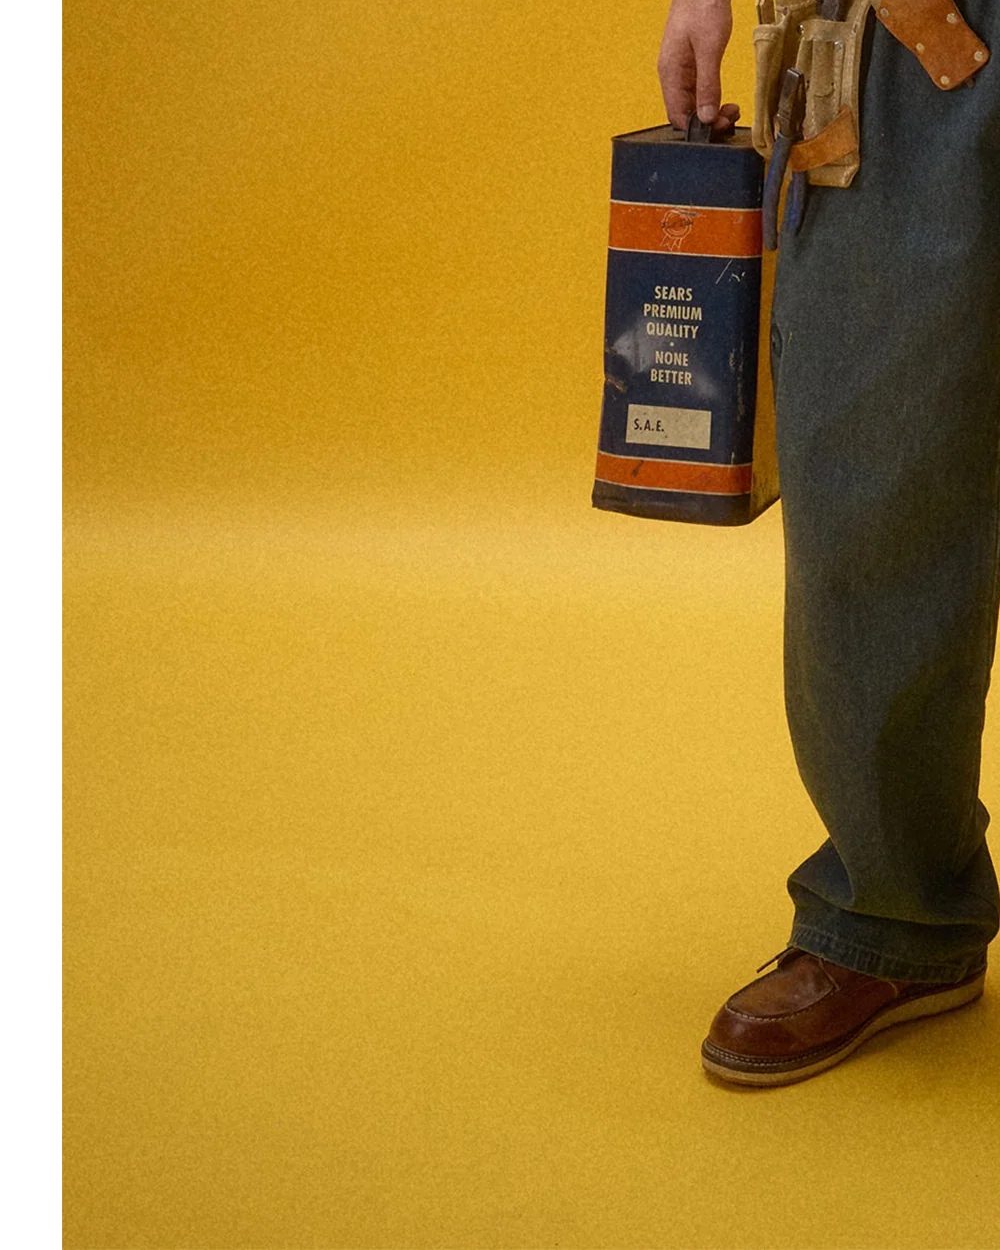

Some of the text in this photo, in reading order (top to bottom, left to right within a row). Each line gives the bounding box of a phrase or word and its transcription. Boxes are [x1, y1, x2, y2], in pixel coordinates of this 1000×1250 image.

[654, 285, 693, 301] SEARS
[643, 303, 702, 321] PREMIUM
[646, 321, 699, 339] QUALITY
[655, 350, 689, 367] NONE
[650, 368, 692, 386] BETTER
[633, 418, 665, 433] S.A.E.
